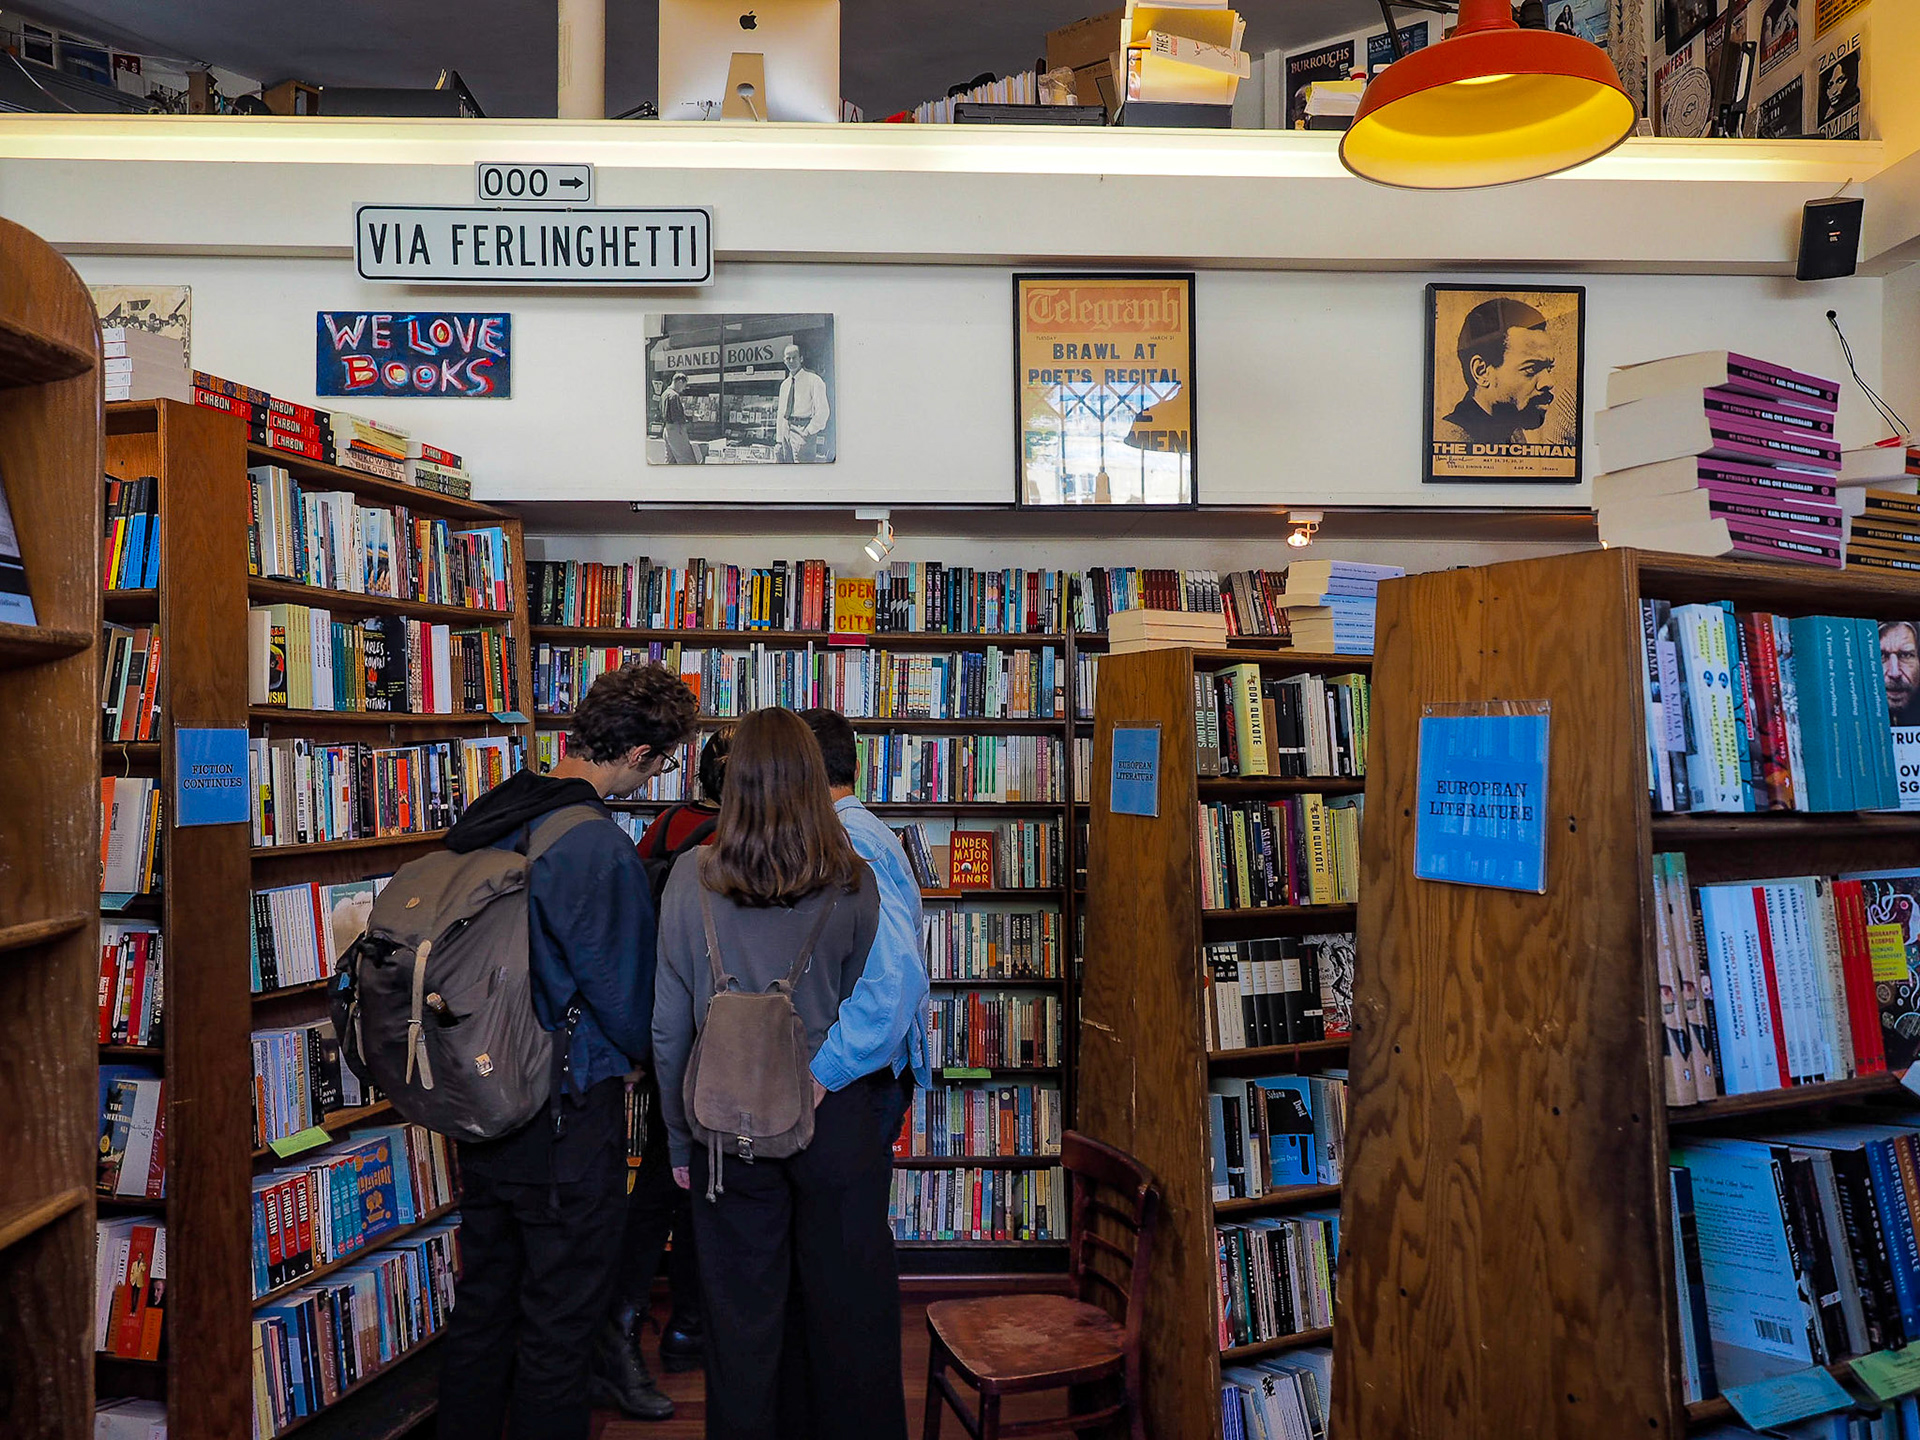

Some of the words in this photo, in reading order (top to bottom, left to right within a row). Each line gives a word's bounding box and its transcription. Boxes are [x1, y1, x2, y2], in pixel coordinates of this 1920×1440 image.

[1291, 47, 1350, 74] BURROUGHS
[1817, 33, 1860, 69] ZADIE
[368, 223, 431, 265] VIA
[451, 224, 698, 267] FERLINGHETTI
[1027, 288, 1180, 331] Telegraph
[323, 314, 393, 350] WE
[407, 315, 505, 357] LOVE
[667, 351, 720, 368] BANNED
[727, 344, 774, 364] BOOKS
[1052, 343, 1120, 360] BRAWL
[1133, 343, 1157, 360] AT
[341, 354, 494, 396] BOOKS
[1028, 368, 1092, 384] POET'S
[1104, 368, 1181, 385] RECITAL
[198, 390, 231, 412] CHABON
[269, 398, 296, 417] HABON
[272, 414, 301, 434] CHABON
[275, 433, 304, 452] CHABON
[1433, 442, 1467, 455] THE
[1472, 443, 1576, 457] DUTCHMAN
[351, 452, 398, 471] BUKOWSKI
[355, 461, 399, 480] BUKOWSKI
[774, 576, 783, 598] WITZ
[837, 583, 875, 599] OPEN
[837, 615, 875, 631] CITY
[1644, 607, 1655, 635] IVAN
[152, 640, 160, 653] SAUL
[1825, 637, 1834, 657] Time
[1844, 637, 1853, 657] Time
[1867, 640, 1876, 659] Time
[1666, 652, 1677, 685] IVAN
[1762, 621, 1774, 669] ALEXANDER
[1769, 671, 1778, 699] KLUGE
[1775, 716, 1784, 739] APRIL
[365, 697, 387, 710] RITING
[1248, 686, 1259, 705] DON
[1829, 672, 1839, 717] Everything
[1848, 671, 1860, 716] Everything
[1871, 674, 1883, 717] Everything
[1195, 710, 1207, 748] OUTLAWS
[1206, 711, 1218, 749] OUTLAWS
[1250, 707, 1262, 746] QUIXOTE
[192, 764, 233, 775] FICTION
[1118, 760, 1152, 770] EUROPEAN
[183, 778, 242, 790] CONTINUES
[1116, 771, 1154, 782] LITERATURE
[1436, 779, 1528, 799] EUROPEAN
[1429, 801, 1533, 822] LITERATURE
[1310, 814, 1321, 832] DON
[954, 837, 990, 851] UNDER
[1261, 828, 1271, 857] ISLAND
[953, 848, 989, 863] MAJOR
[1313, 835, 1325, 873] QUIXOTE
[952, 874, 989, 883] MINOR
[1732, 973, 1742, 1000] THERE
[1755, 972, 1766, 998] THERE
[1736, 1003, 1747, 1037] BELOW
[1759, 1001, 1770, 1035] BELOW
[281, 1186, 294, 1228] CHABON
[296, 1181, 308, 1222] CHABON
[1886, 1143, 1909, 1227] INDEPENDENT
[1905, 1229, 1920, 1273] PEOPLE
[265, 1193, 279, 1235] CHABON
